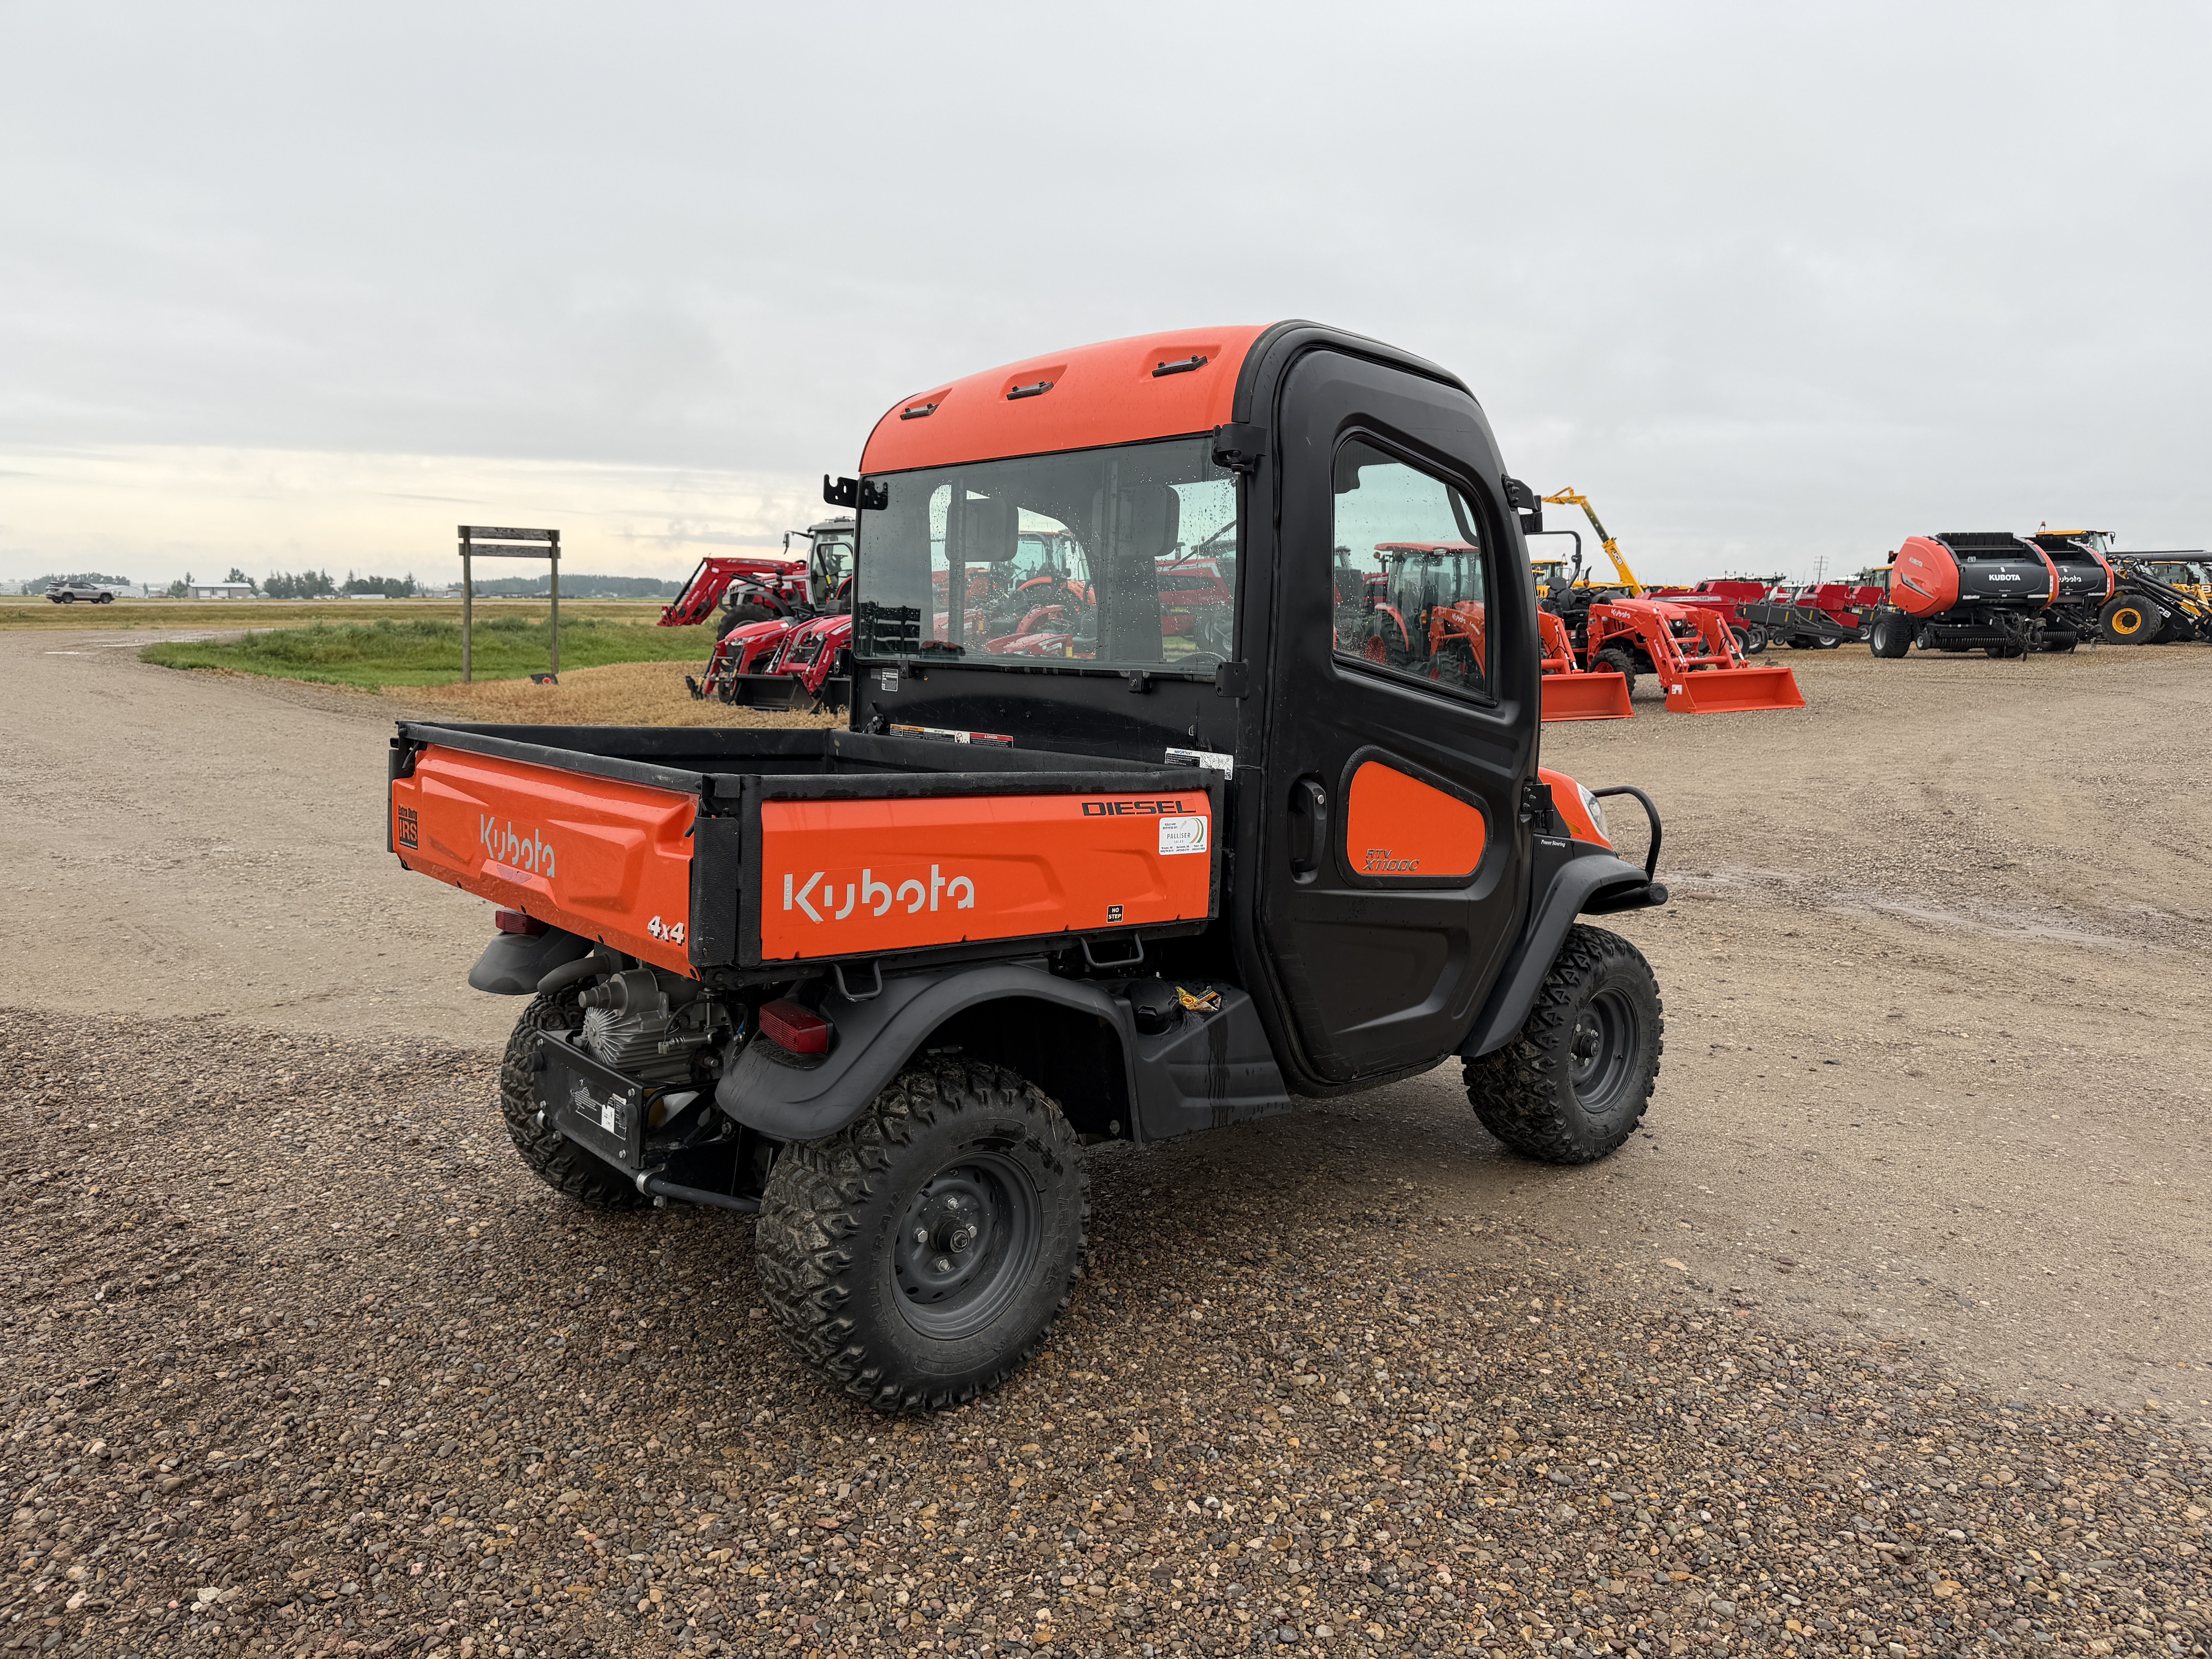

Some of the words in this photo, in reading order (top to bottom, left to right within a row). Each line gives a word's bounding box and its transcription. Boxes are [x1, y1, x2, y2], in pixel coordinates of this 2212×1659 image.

[1612, 550, 1623, 565] JCB
[1611, 608, 1631, 619] Kubota
[1082, 801, 1196, 816] DIESEL
[400, 819, 417, 842] IRS
[481, 814, 555, 878] Kubota
[1366, 848, 1393, 859] RTV
[1362, 859, 1420, 871] X1100C
[783, 864, 974, 922] Kubota
[647, 915, 685, 947] 4x4
